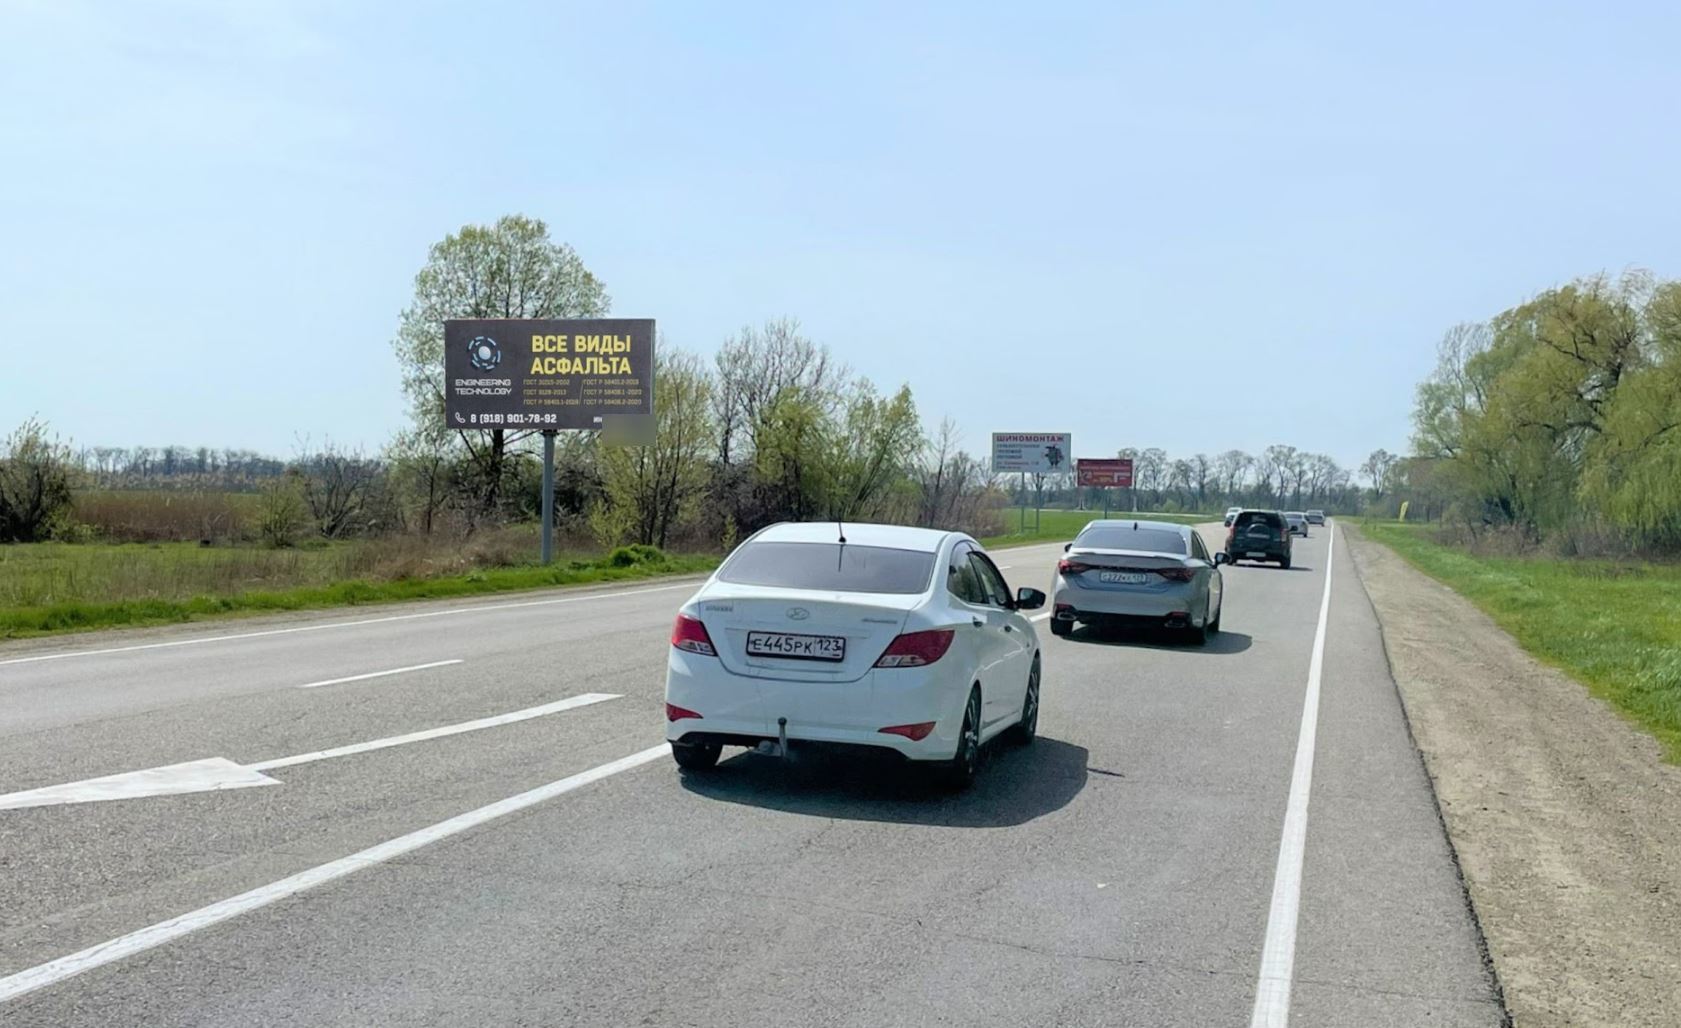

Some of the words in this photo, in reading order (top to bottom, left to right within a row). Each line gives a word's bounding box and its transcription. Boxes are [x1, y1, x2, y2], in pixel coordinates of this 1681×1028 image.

[532, 335, 568, 352] ВСЕ
[574, 335, 631, 355] ВИДЫ
[530, 357, 632, 375] АСФАЛЬТА
[455, 378, 512, 387] ENGINEERING
[455, 387, 512, 396] TECHNOLOGY
[470, 414, 477, 423] 8
[479, 413, 504, 424] (918)
[506, 414, 558, 423] 901-78-92
[996, 435, 1064, 443] ШИНОМОНТАЖ
[817, 638, 840, 652] 123
